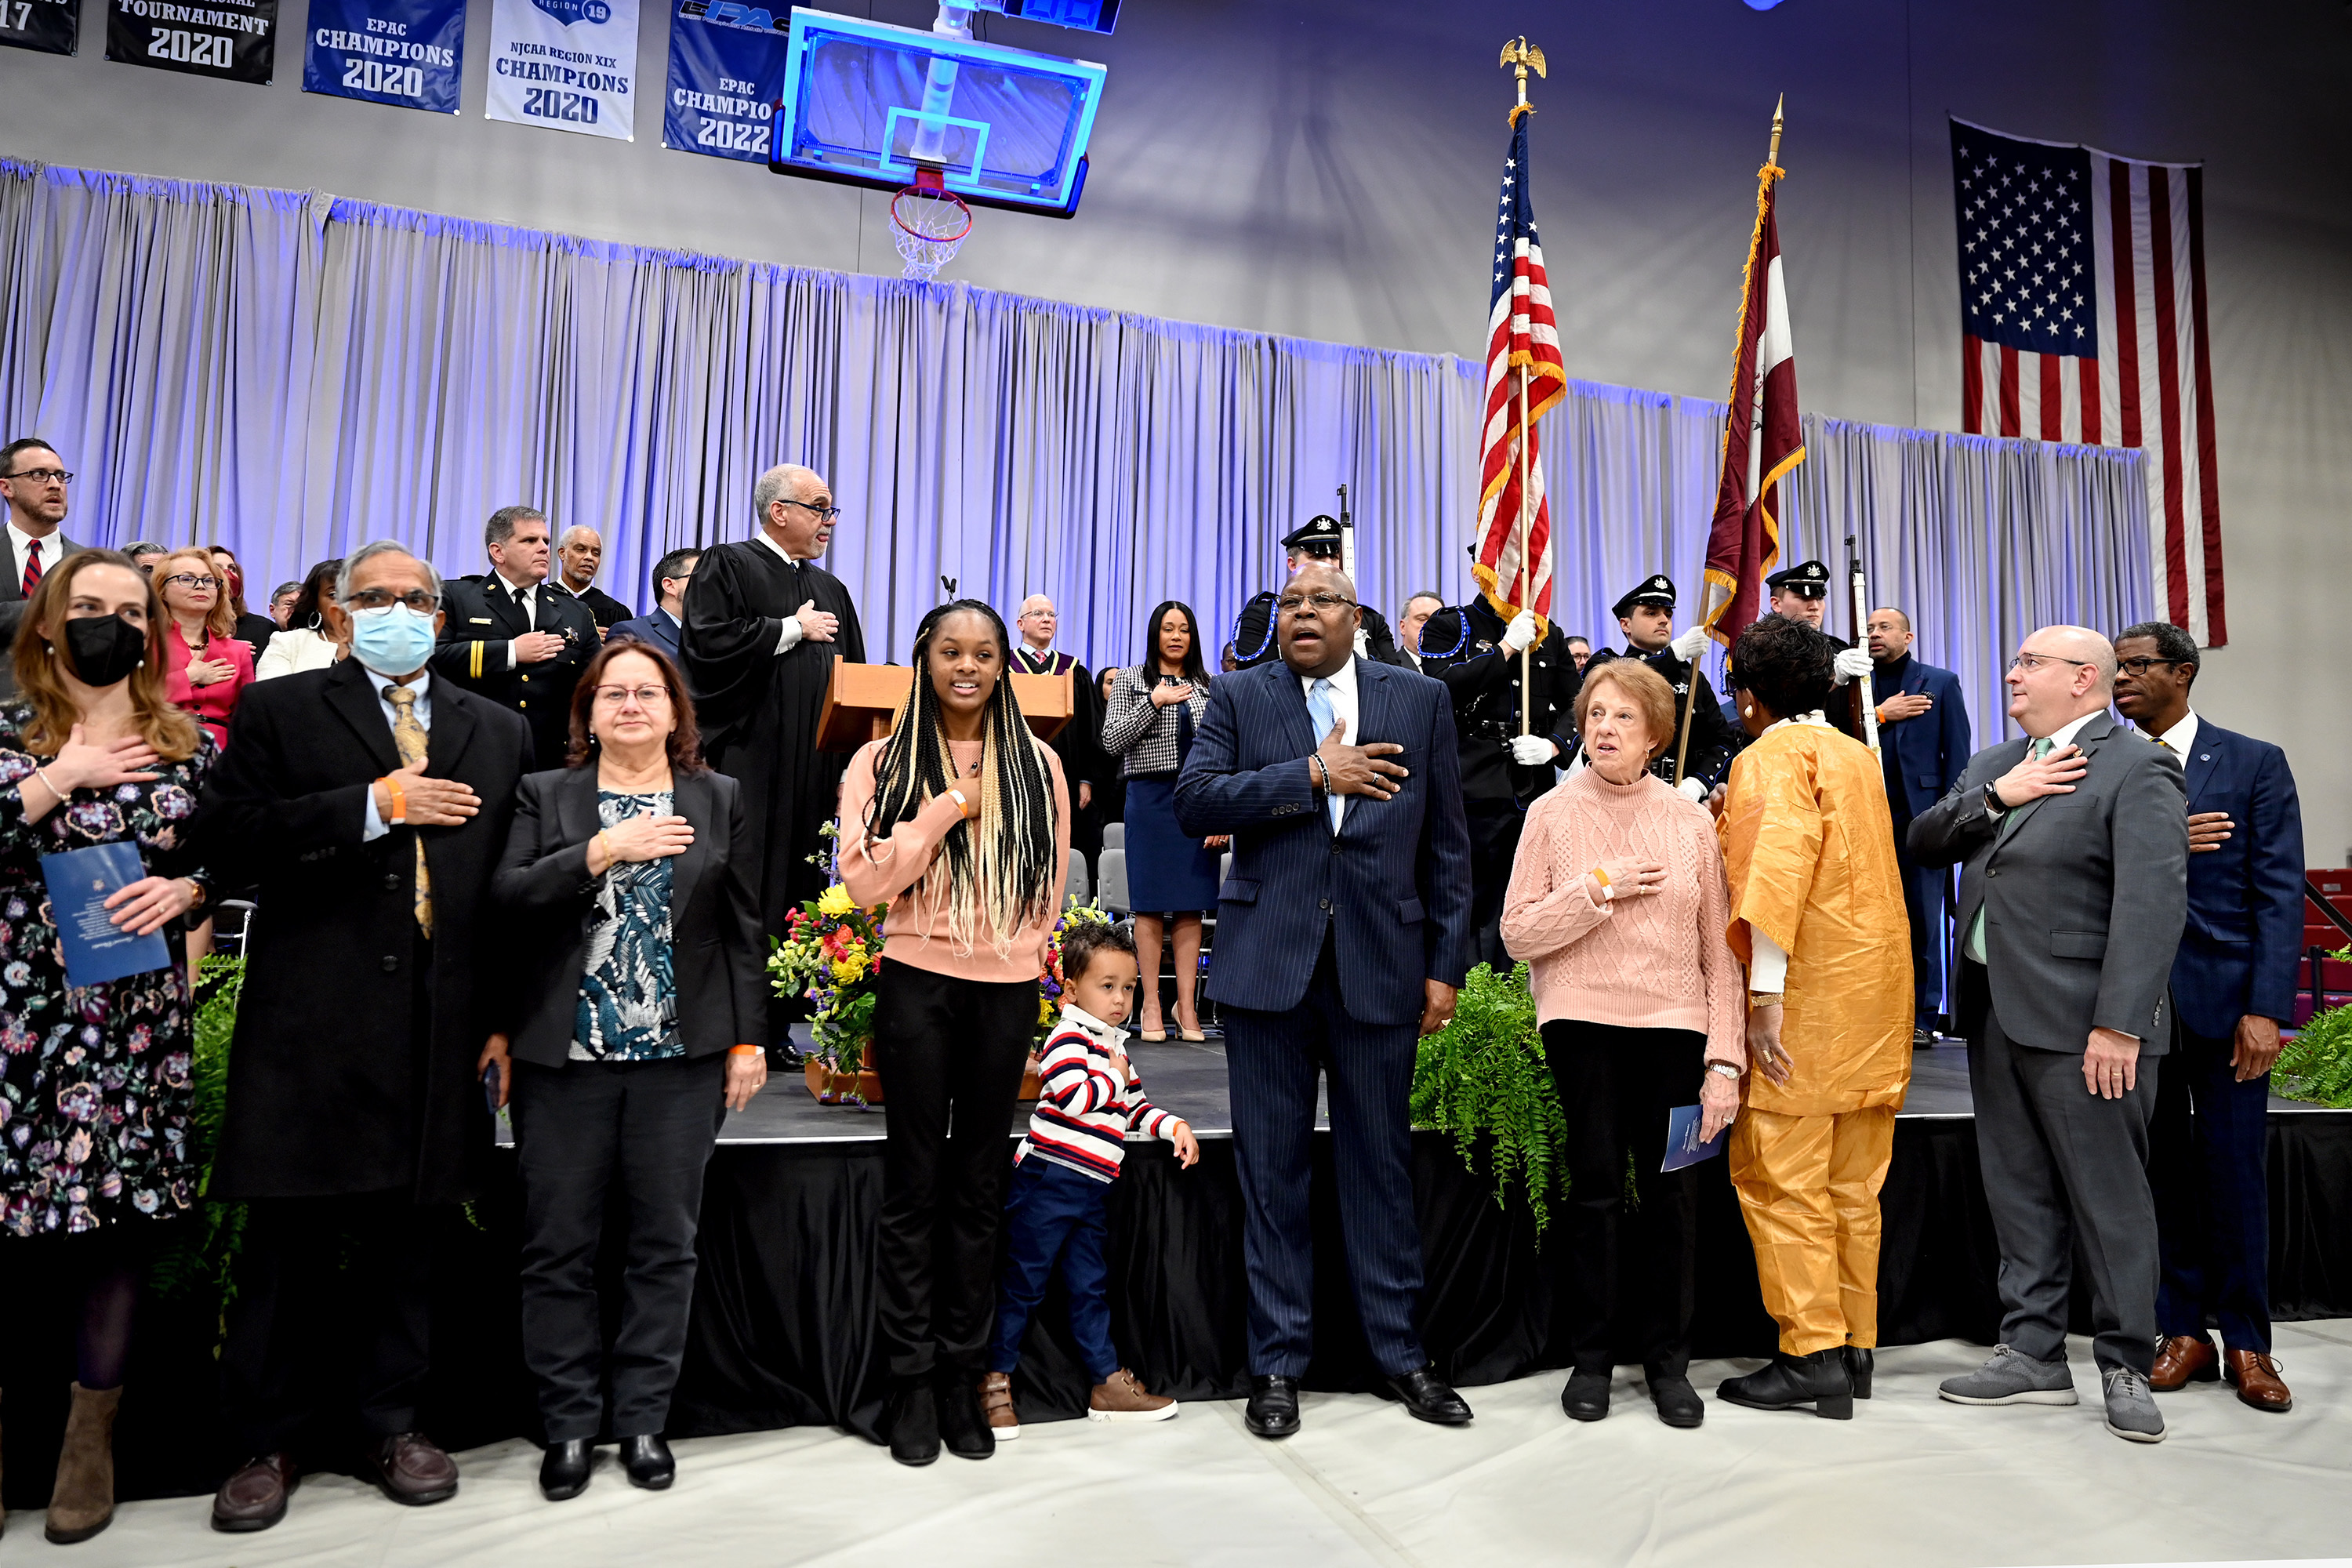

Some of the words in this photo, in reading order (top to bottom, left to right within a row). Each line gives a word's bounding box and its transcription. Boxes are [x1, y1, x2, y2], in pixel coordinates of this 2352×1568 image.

[120, 0, 269, 36] TOURNAMENT
[366, 17, 407, 36] EPAC
[539, 0, 578, 11] REGION
[588, 4, 607, 20] 19
[147, 27, 234, 68] 2020
[315, 28, 454, 67] CHAMPIONS
[510, 42, 546, 56] NJCAA
[549, 46, 593, 64] REGION
[595, 55, 617, 69] XIX
[342, 58, 423, 97] 2020
[495, 57, 629, 94] CHAMPIONS
[719, 77, 755, 96] EPAC
[523, 87, 599, 124] 2020
[673, 87, 772, 121] CHAMPIO
[697, 116, 771, 155] 2022
